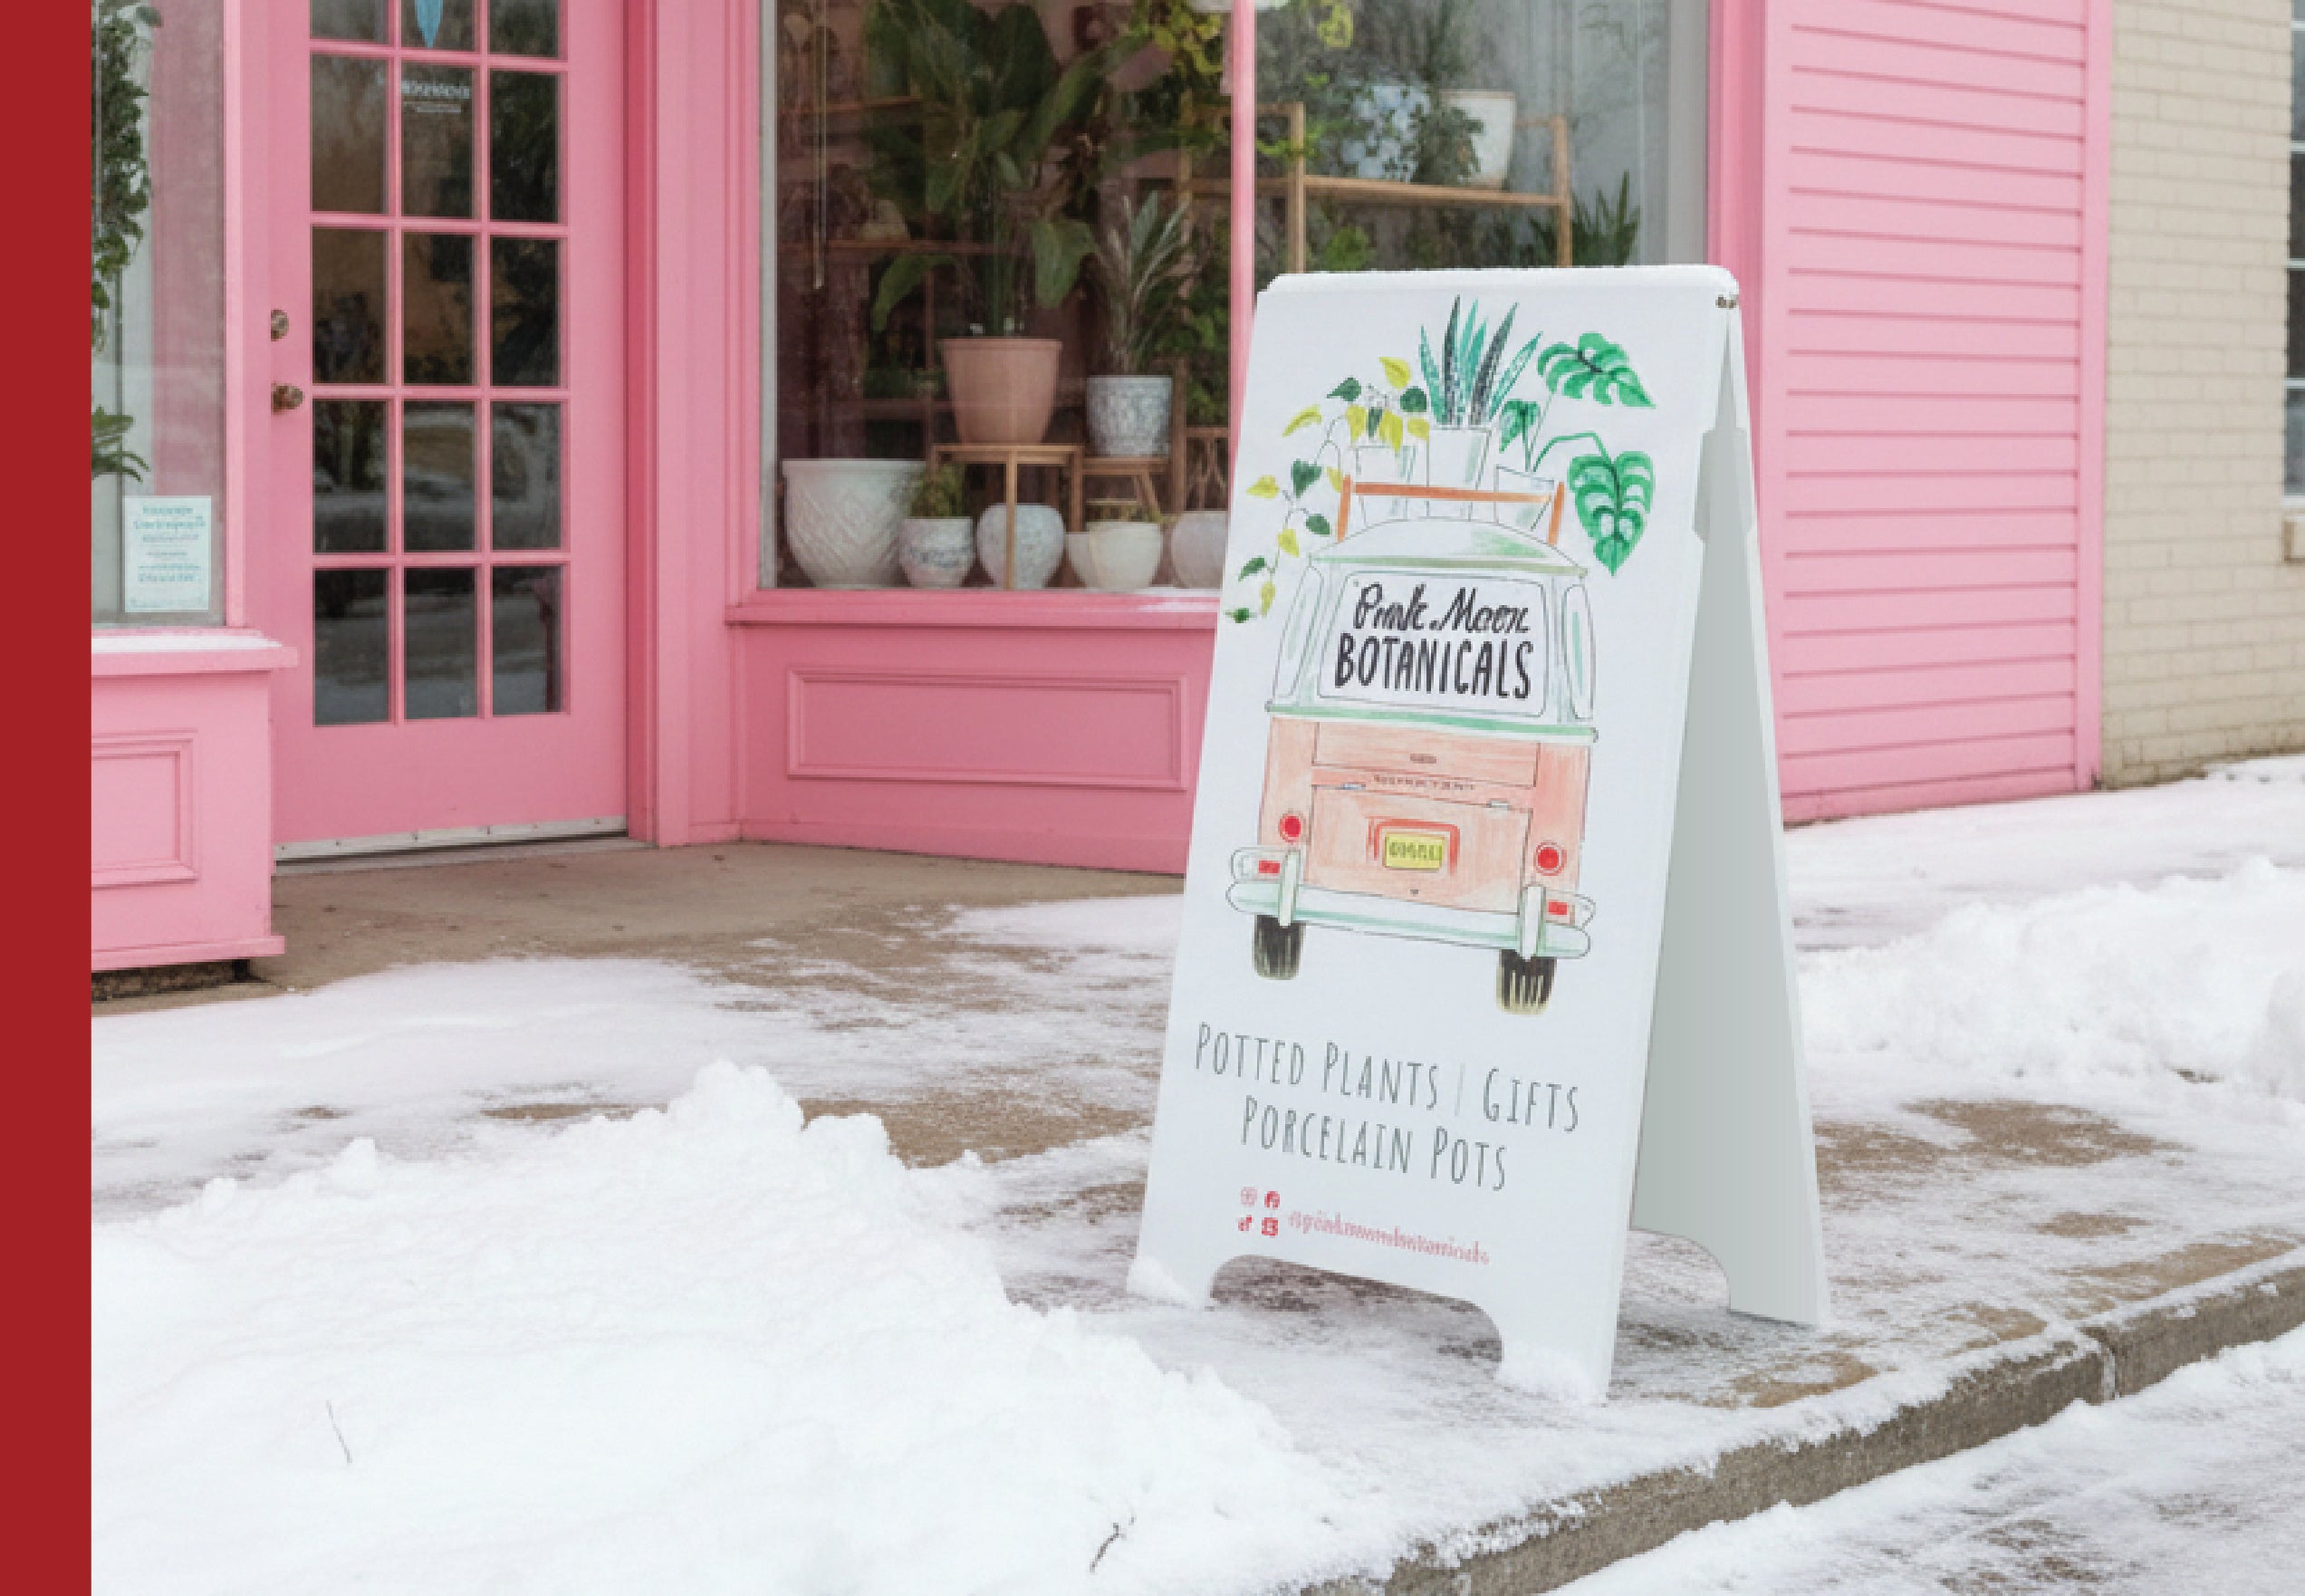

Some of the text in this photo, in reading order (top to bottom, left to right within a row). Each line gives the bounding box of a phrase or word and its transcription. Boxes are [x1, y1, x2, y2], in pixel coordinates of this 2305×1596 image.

[1353, 582, 1531, 633] Pink Moon
[1335, 632, 1533, 700] BOTANICALS
[1196, 1022, 1304, 1086] POTTED
[1321, 1040, 1438, 1110] PLANTS
[1483, 1067, 1579, 1132] GIFTS
[1241, 1094, 1507, 1191] PORCELAIN POTS
